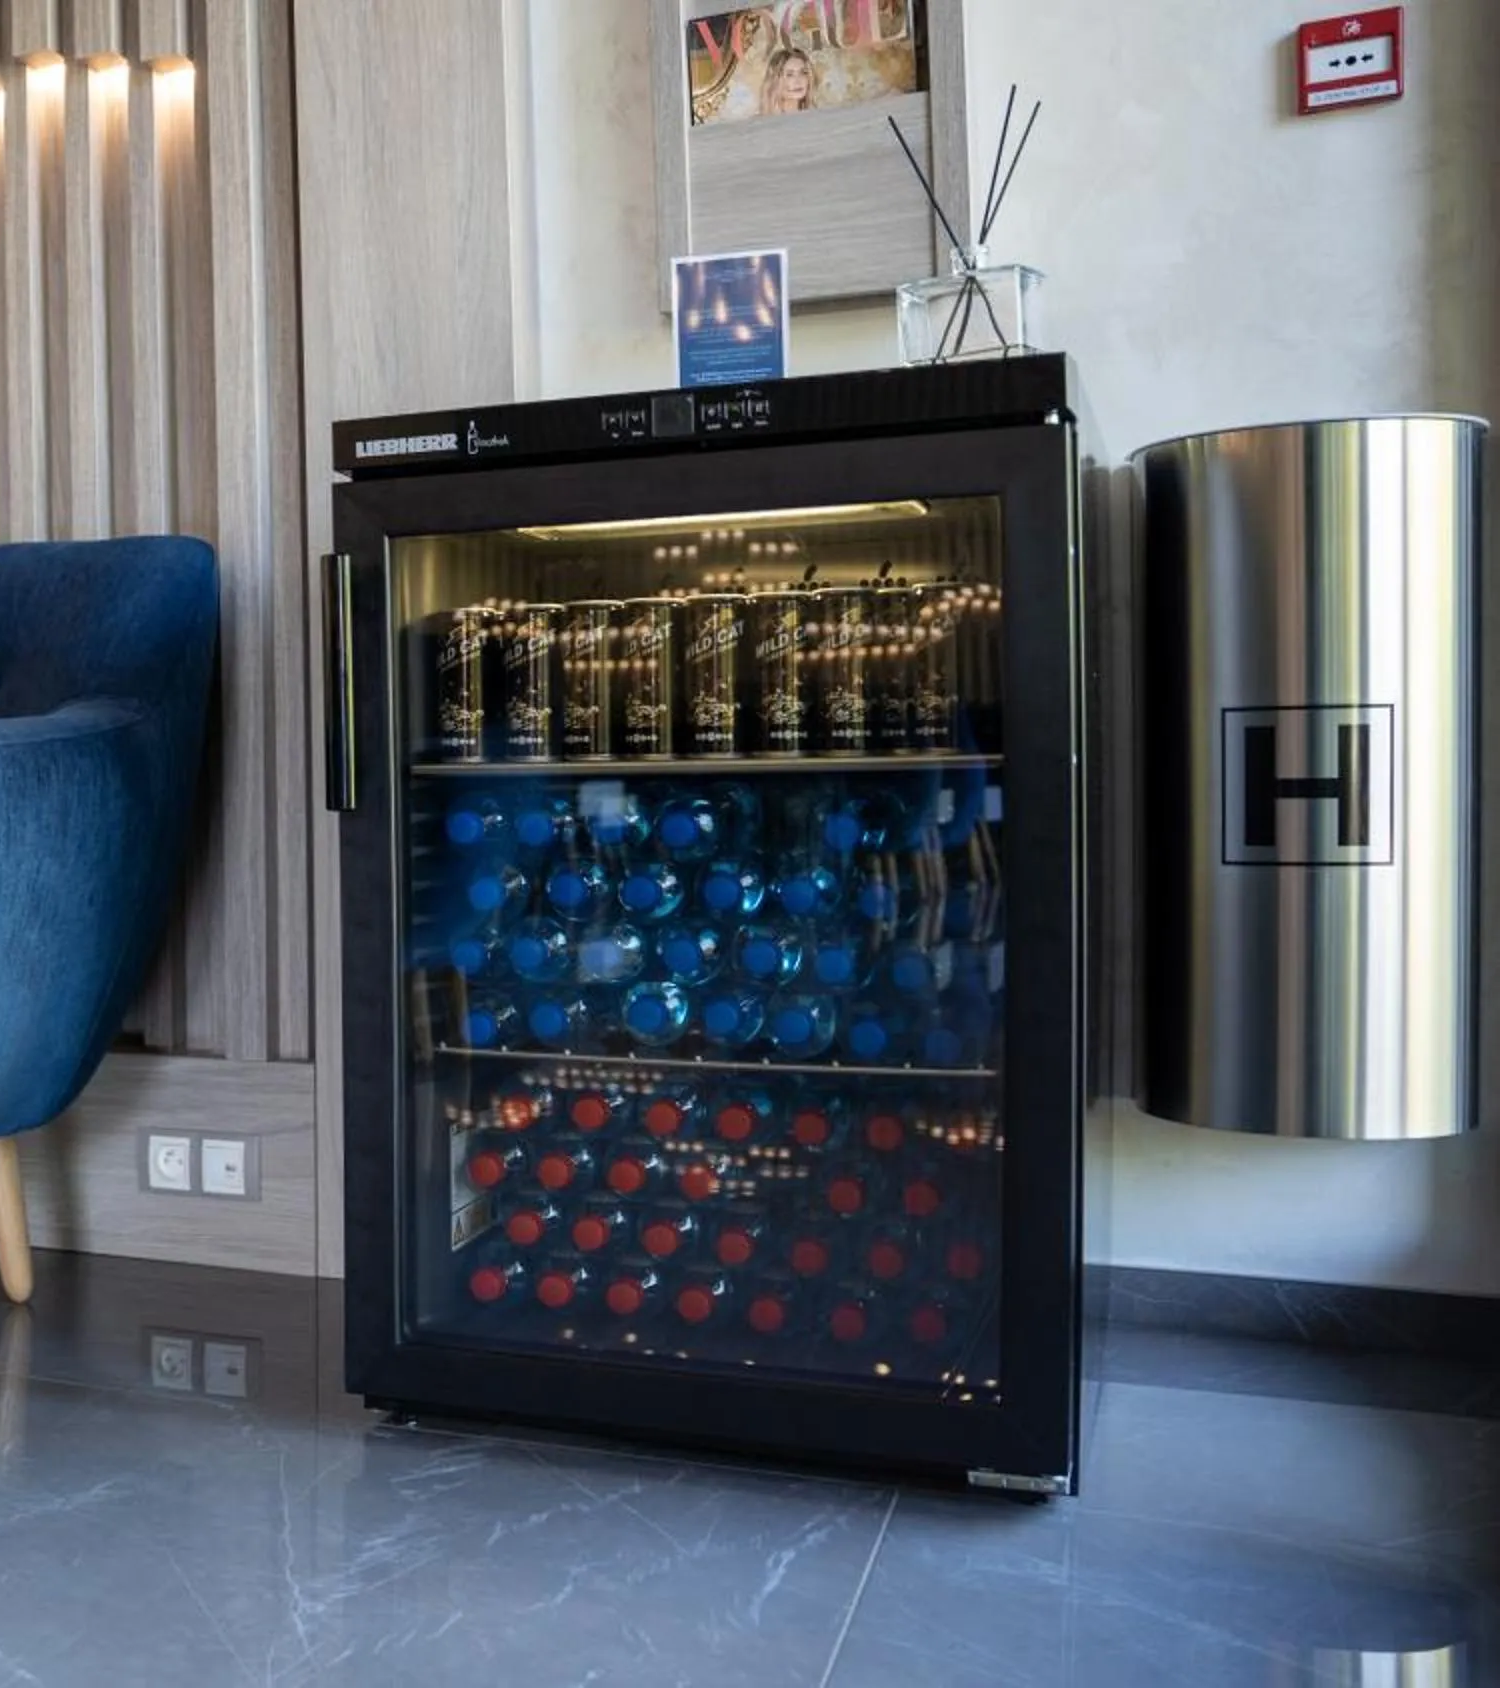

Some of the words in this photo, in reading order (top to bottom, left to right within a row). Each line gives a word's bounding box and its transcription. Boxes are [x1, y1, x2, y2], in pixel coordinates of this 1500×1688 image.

[694, 0, 908, 68] VOGUE
[355, 433, 458, 458] LIEBHERR
[641, 621, 673, 646] CAT
[717, 620, 745, 643] CAT
[1244, 724, 1370, 846] H
